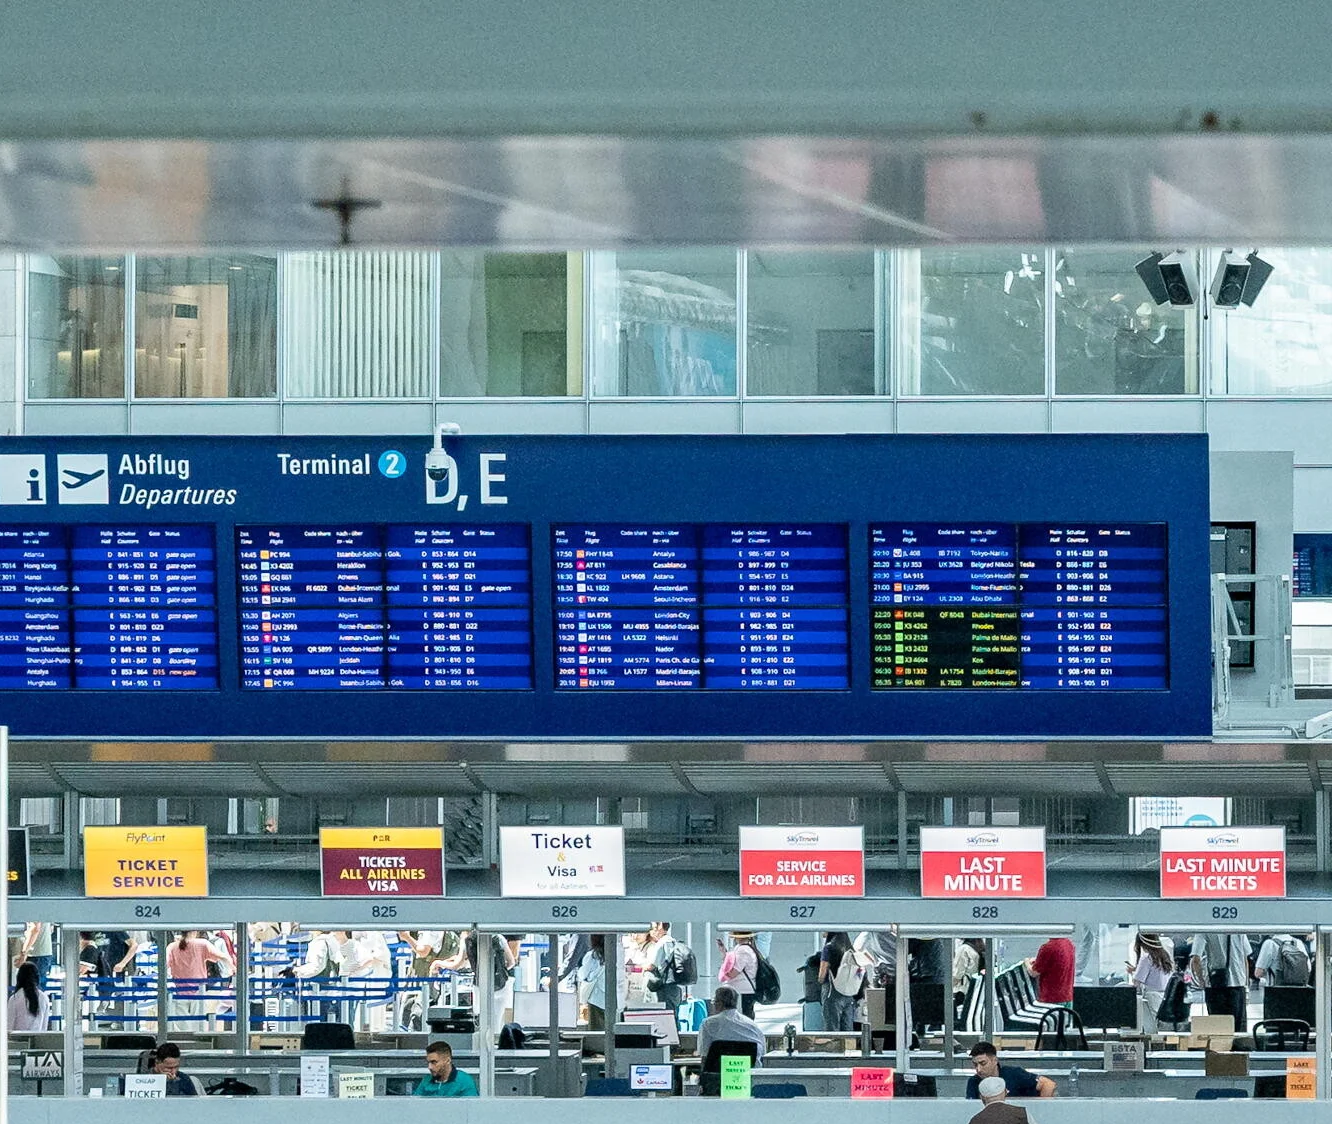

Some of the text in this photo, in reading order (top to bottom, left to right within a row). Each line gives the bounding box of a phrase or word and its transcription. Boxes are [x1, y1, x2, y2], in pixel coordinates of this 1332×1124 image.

[119, 454, 189, 479] Abflug
[277, 453, 399, 475] Terminal 2
[479, 453, 508, 504] E
[119, 484, 236, 509] Departures
[531, 833, 592, 849] Ticket
[359, 856, 406, 868] TICKETS
[557, 852, 567, 862] &
[117, 859, 178, 871] TICKET
[547, 865, 577, 877] Visa
[777, 861, 826, 873] SERVICE
[960, 857, 1005, 873] LAST
[1166, 858, 1280, 873] LAST MINUTE
[340, 868, 426, 880] ALL AIRLINES
[112, 876, 185, 888] SERVICE
[367, 880, 399, 892] VISA
[748, 875, 855, 887] FOR ALL AIRLINES
[944, 875, 1023, 891] MINUTE
[1189, 875, 1258, 891] TICKETS
[135, 906, 161, 918] 824
[372, 906, 398, 918] 825
[552, 906, 578, 918] 826
[790, 906, 815, 918] 827
[972, 906, 998, 919] 828
[1212, 908, 1238, 920] 829
[26, 1070, 60, 1078] AIRWAYS
[129, 1090, 162, 1098] TICKET
